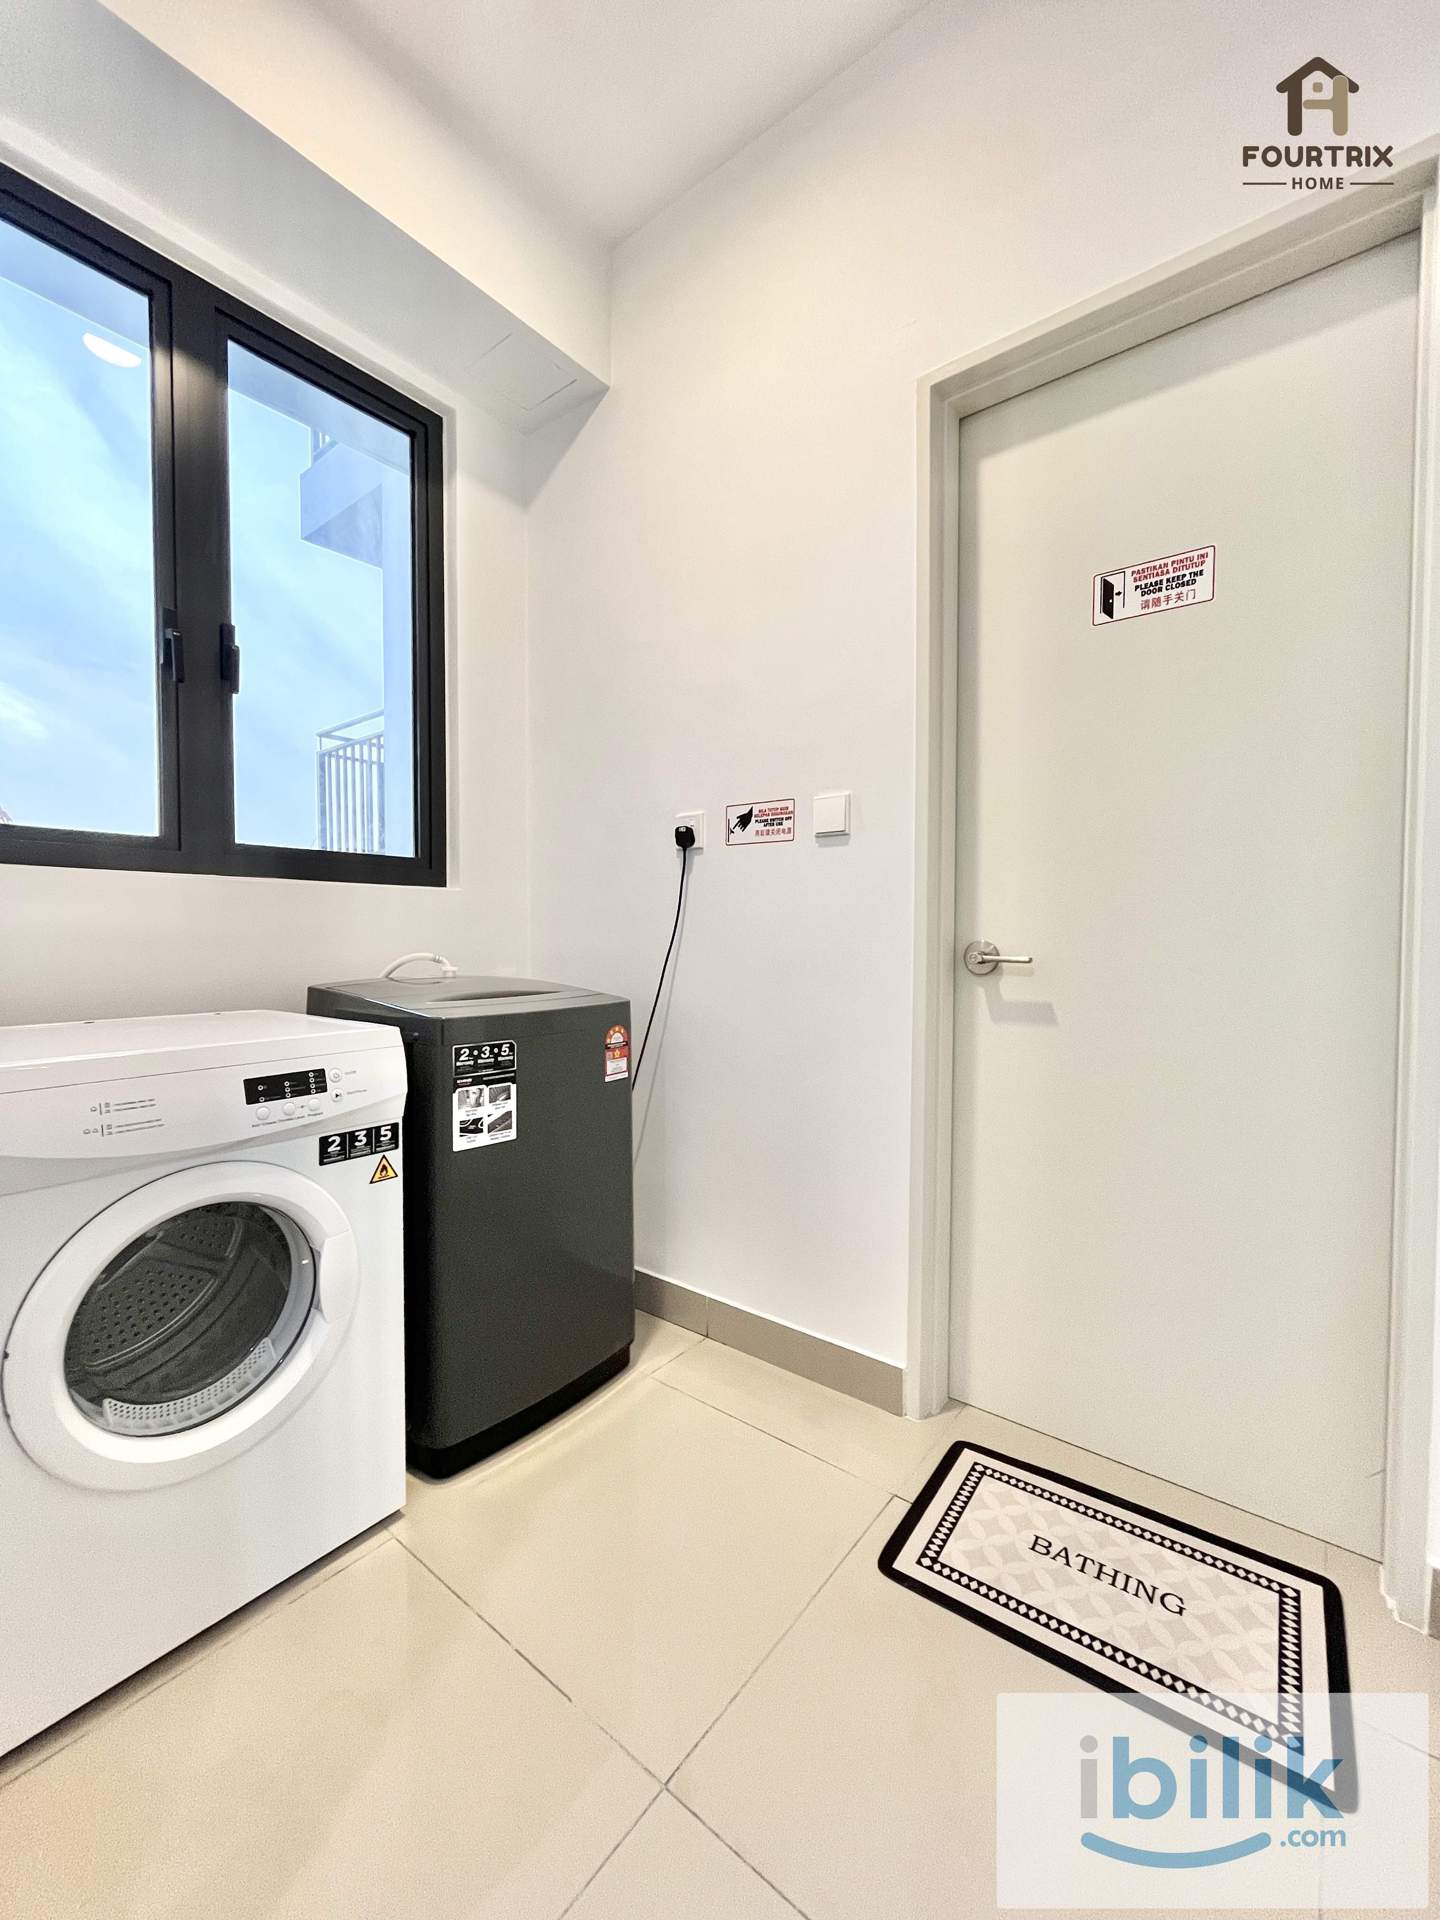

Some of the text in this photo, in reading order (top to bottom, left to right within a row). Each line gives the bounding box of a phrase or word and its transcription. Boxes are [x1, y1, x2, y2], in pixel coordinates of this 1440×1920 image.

[1131, 552, 1209, 577] PASTIKAN PINTU INI
[1133, 560, 1206, 583] SENTIASA DITUTUP
[1134, 569, 1204, 592] PLEASE KEEP THE
[1140, 578, 1197, 597] DOOR CLOSED
[458, 1043, 510, 1061] 2 3 5
[327, 1135, 341, 1152] 2
[354, 1130, 367, 1146] 3
[379, 1125, 392, 1141] 5
[1027, 1534, 1187, 1617] BATHING
